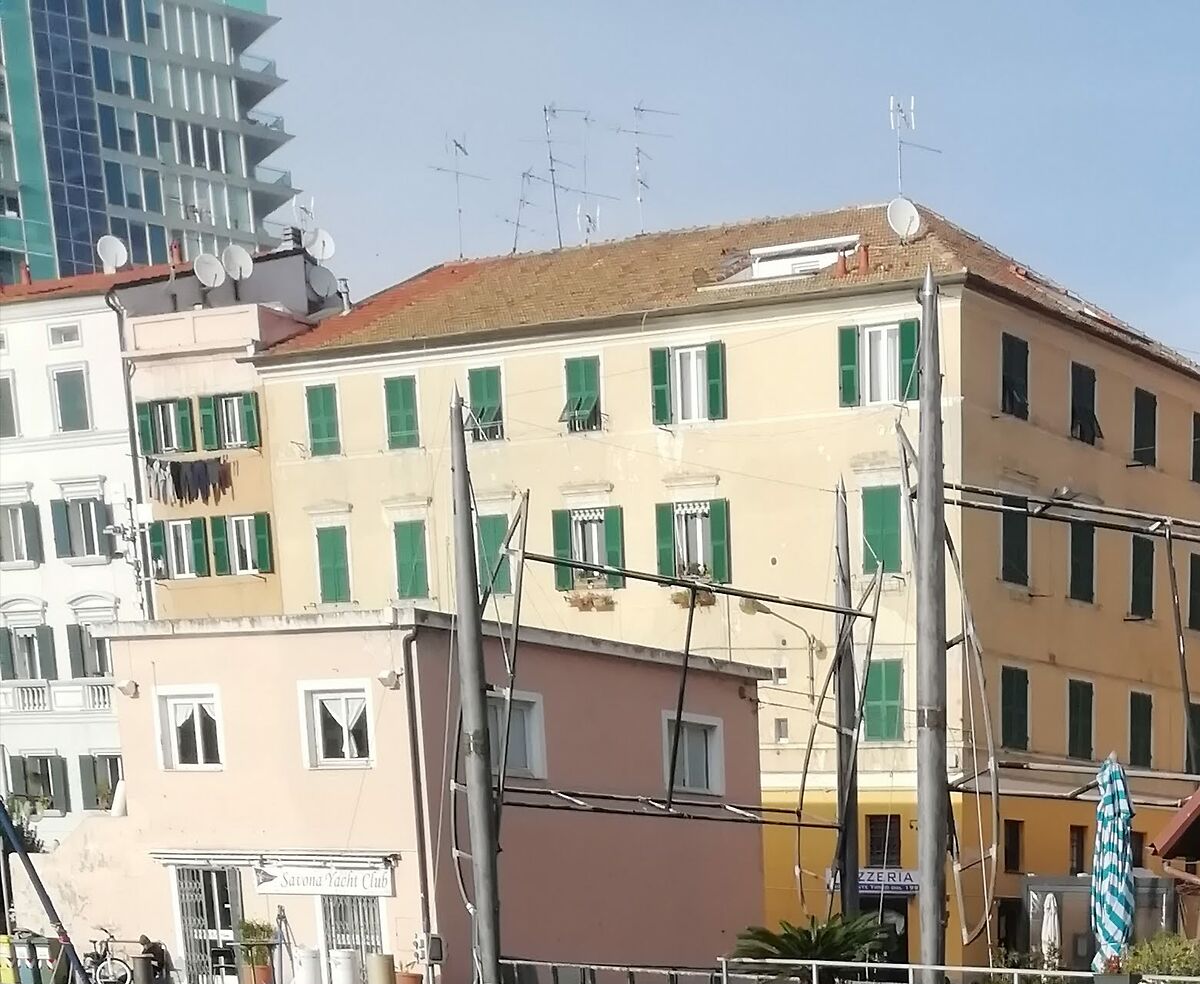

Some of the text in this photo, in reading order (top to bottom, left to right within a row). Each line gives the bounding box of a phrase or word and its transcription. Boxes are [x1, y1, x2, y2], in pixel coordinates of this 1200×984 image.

[280, 870, 389, 890] Savona Yacht Club
[859, 871, 914, 883] ZZERIA
